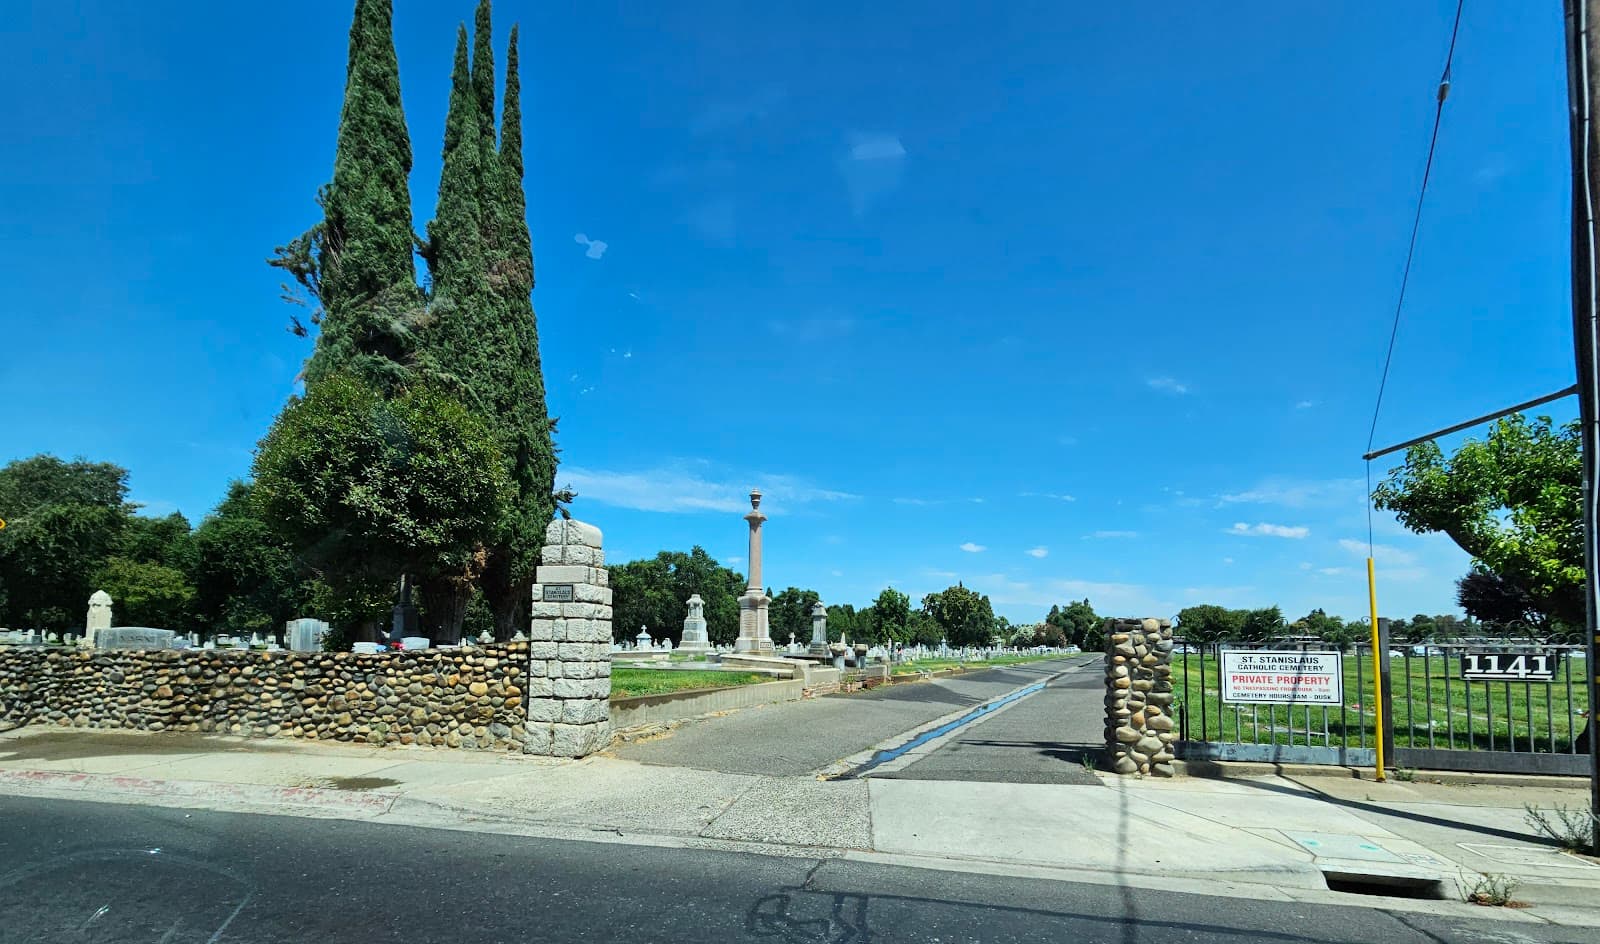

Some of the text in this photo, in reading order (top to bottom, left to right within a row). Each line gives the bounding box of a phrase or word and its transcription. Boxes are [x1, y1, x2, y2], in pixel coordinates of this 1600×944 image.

[1241, 656, 1319, 665] ST. STANISLAUS
[1465, 655, 1552, 678] 1141
[1232, 675, 1330, 686] PRIVATE PROPERTY
